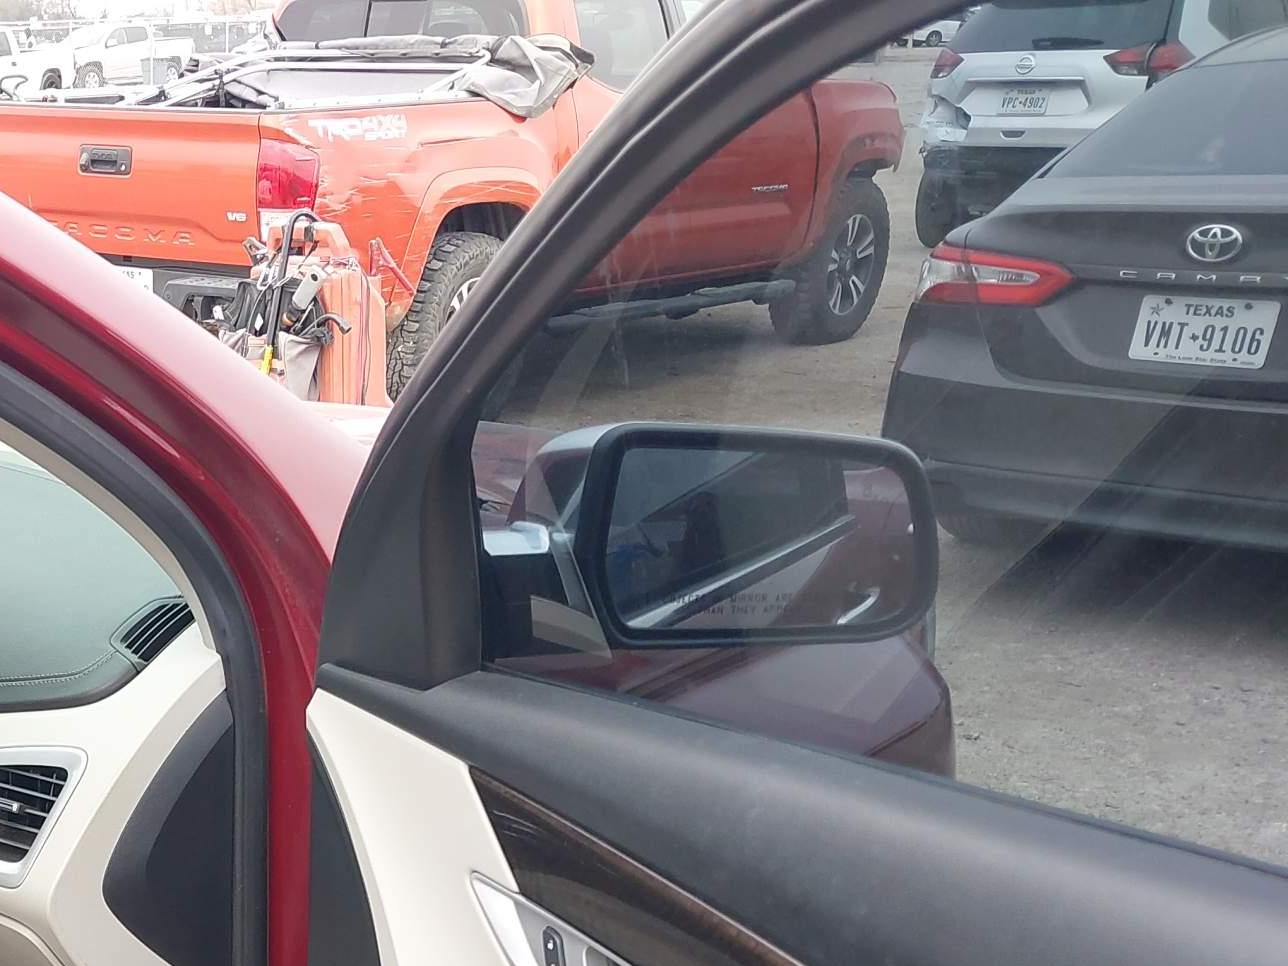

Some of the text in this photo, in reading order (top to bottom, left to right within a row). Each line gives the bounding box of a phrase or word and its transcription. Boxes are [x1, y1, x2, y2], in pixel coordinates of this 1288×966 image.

[225, 211, 247, 223] V6
[1119, 270, 1288, 283] CAMR
[1184, 303, 1236, 319] TEXAS
